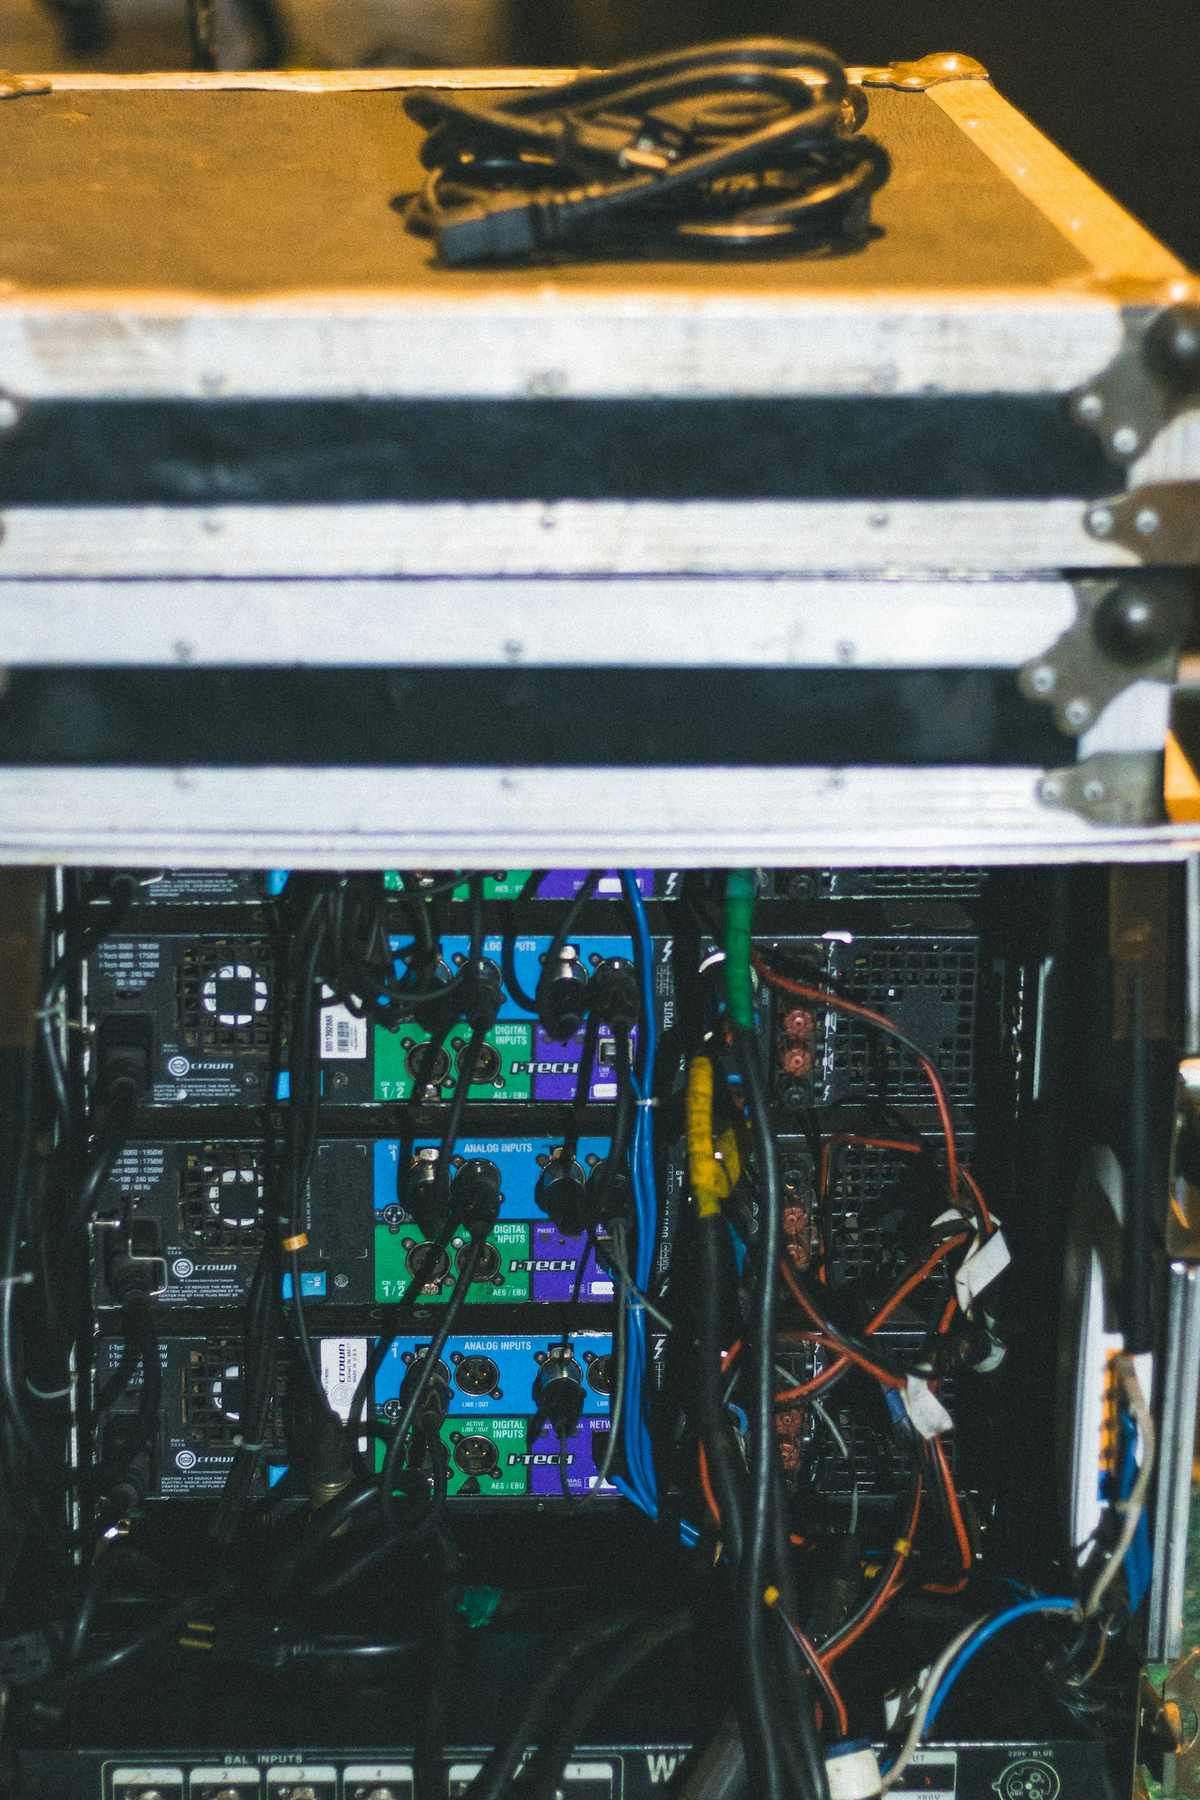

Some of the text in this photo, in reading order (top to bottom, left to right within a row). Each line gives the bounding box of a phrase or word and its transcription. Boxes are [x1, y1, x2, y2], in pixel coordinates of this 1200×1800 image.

[664, 1000, 674, 1031] TPUTS
[495, 1026, 528, 1035] DIGITAL
[495, 1036, 528, 1045] INPUTS
[464, 1143, 533, 1153] ANALOG INPUTS
[494, 1225, 526, 1234] DIGITAL
[194, 1264, 237, 1272] crown
[464, 1341, 532, 1350] ANALOG INPUTS
[338, 1344, 346, 1383] crown
[492, 1420, 525, 1429] DIGITAL
[493, 1430, 524, 1439] INPUTS
[511, 1481, 525, 1489] EBU
[224, 1754, 304, 1765] BAL INPUTS
